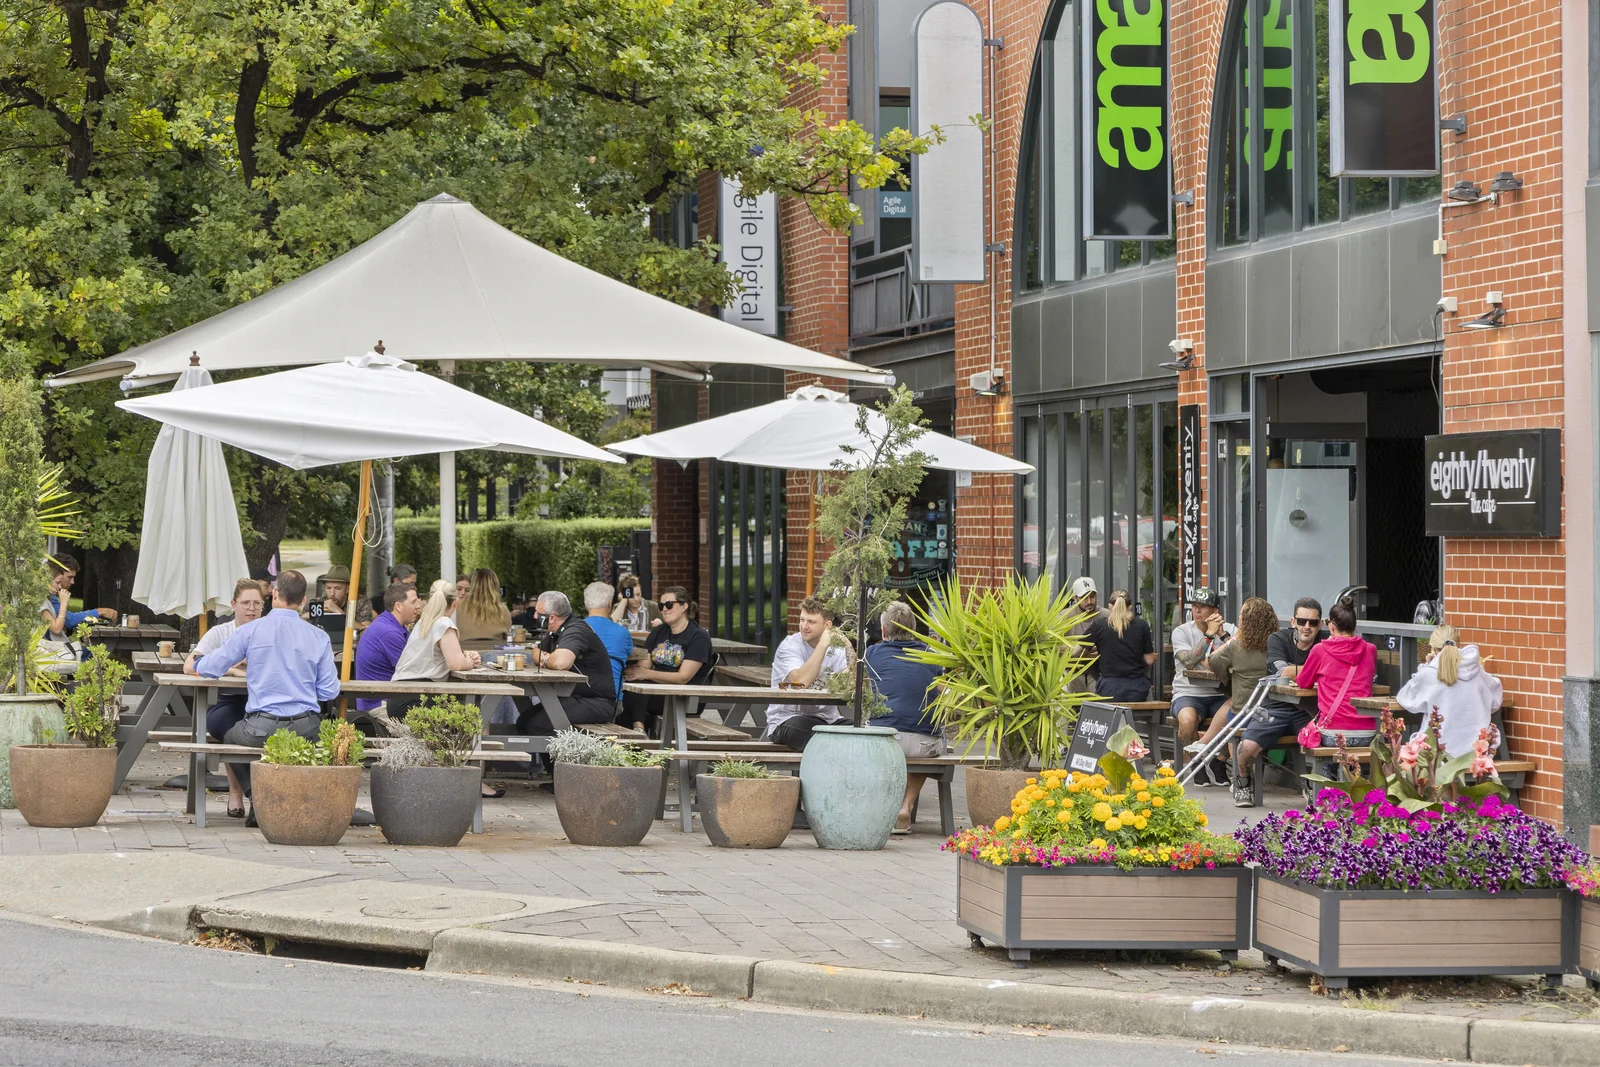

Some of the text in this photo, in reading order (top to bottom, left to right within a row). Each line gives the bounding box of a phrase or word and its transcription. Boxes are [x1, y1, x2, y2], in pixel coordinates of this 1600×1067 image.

[883, 196, 902, 206] Agile
[883, 205, 907, 215] Digital
[733, 193, 765, 322] gile Digital
[1430, 447, 1536, 500] eighty/twenty
[1470, 490, 1497, 525] the cafe
[891, 540, 938, 558] AFE
[625, 588, 631, 598] 6
[310, 604, 323, 617] 36
[540, 615, 547, 627] 7
[1388, 636, 1396, 649] 5
